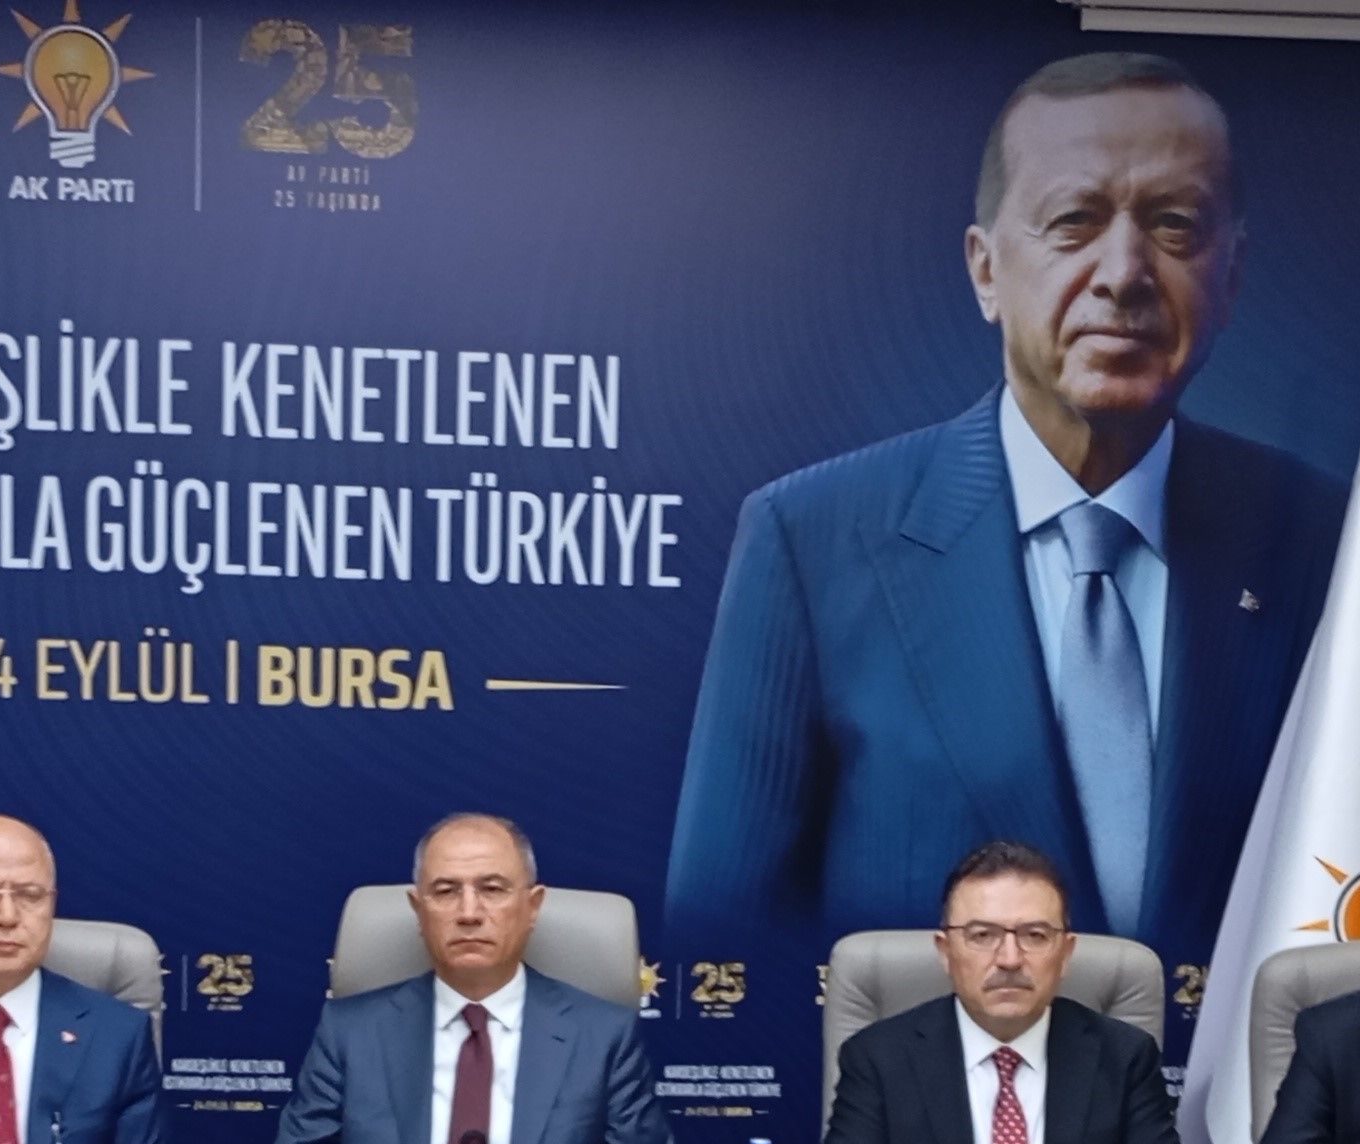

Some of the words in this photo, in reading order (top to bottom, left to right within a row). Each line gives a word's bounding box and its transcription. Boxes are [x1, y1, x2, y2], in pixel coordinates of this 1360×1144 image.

[239, 18, 419, 158] 25
[8, 175, 49, 200] AK
[221, 341, 620, 450] KENETLENEN
[85, 459, 412, 595] GÜÇLENEN
[426, 472, 683, 589] TÜRKİYE
[36, 626, 209, 704] EYLÜL
[258, 644, 454, 711] BURSA
[195, 953, 254, 996] 25
[691, 962, 746, 1004] 25
[1173, 964, 1209, 1005] 2
